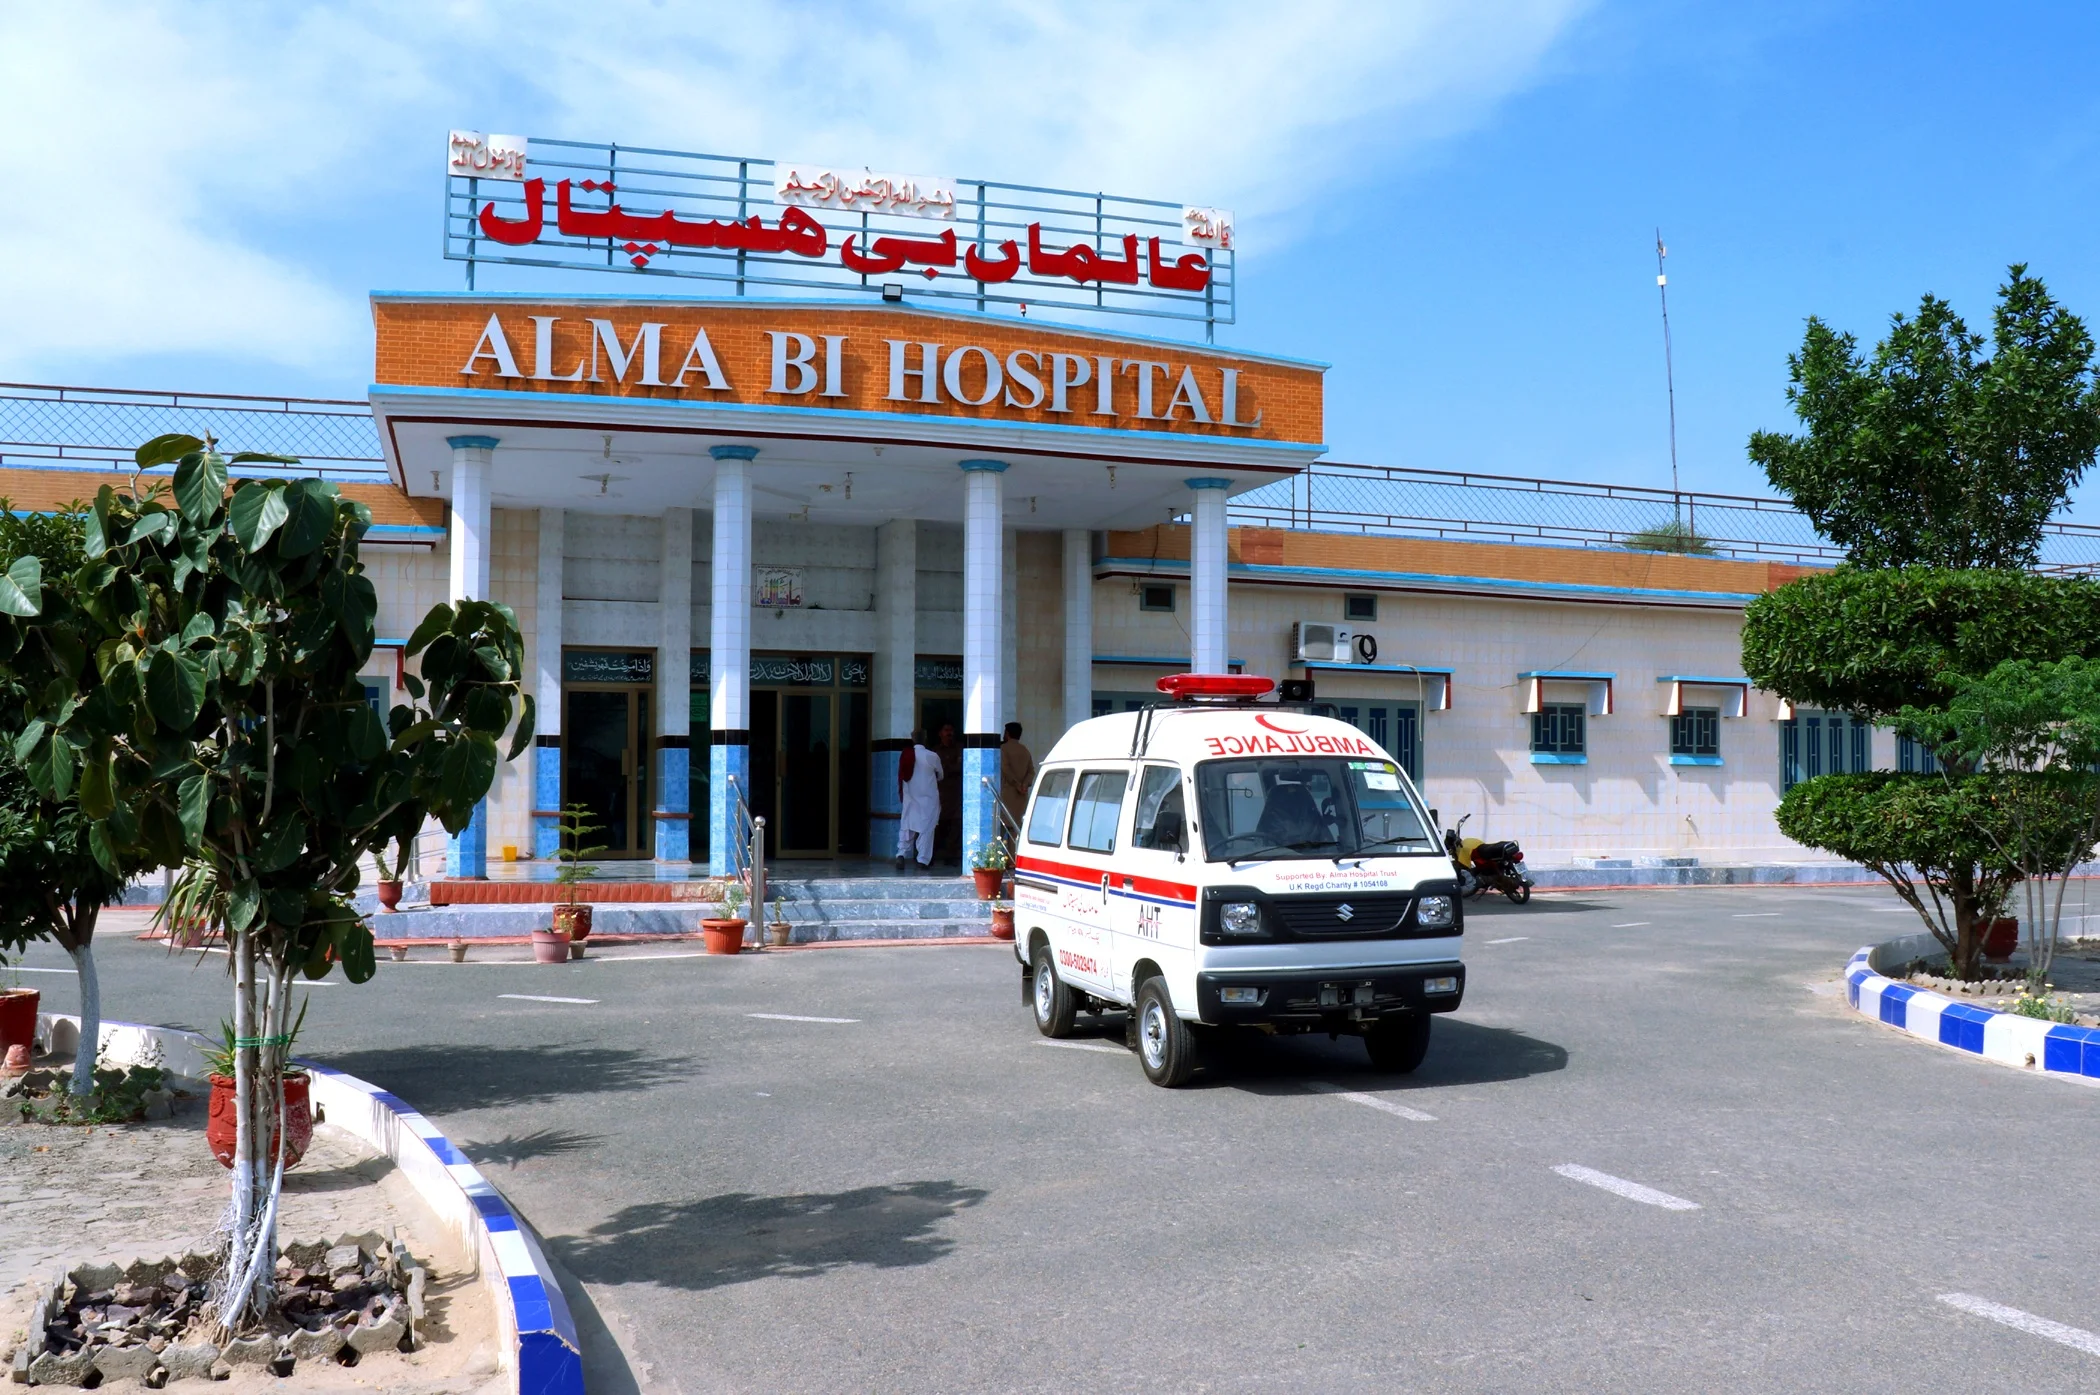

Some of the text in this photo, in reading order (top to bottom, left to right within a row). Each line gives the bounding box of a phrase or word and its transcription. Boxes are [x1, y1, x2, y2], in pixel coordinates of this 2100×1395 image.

[459, 312, 1262, 428] ALMA BI HOSPITAL
[1275, 873, 1314, 882] Supported
[1350, 871, 1379, 880] Hospital
[1304, 883, 1324, 891] Regd
[1325, 881, 1352, 890] Charity
[1137, 903, 1162, 939] AHT
